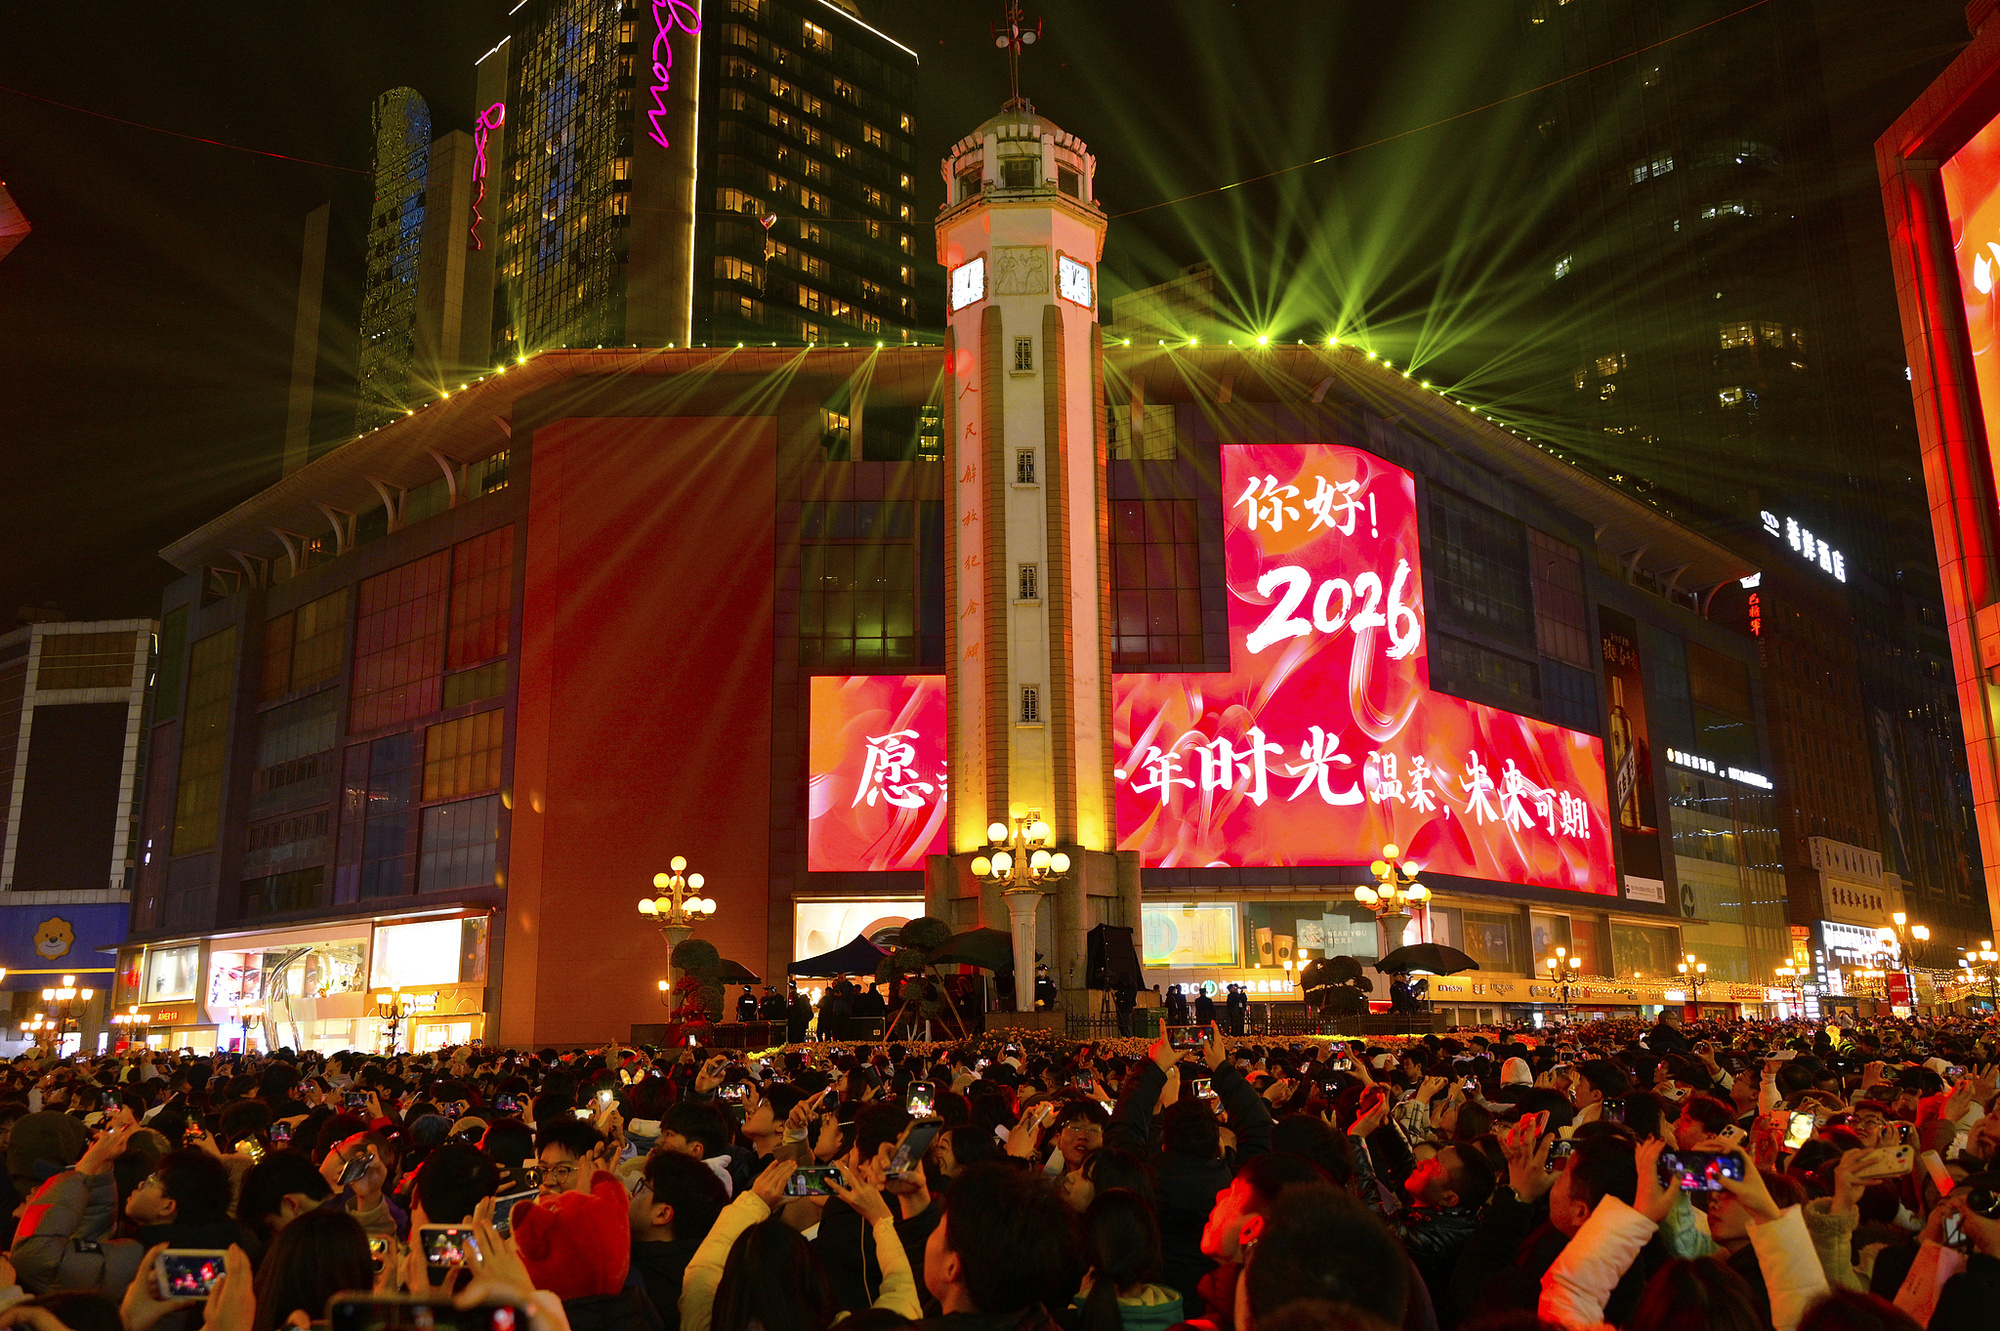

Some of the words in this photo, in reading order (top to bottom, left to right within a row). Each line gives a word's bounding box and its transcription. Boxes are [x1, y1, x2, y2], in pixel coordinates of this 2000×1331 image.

[1232, 473, 1379, 539] 你好！
[1786, 516, 1846, 583] 希岸酒店
[1246, 558, 1421, 661] 2026
[1327, 929, 1348, 938] NEAR
